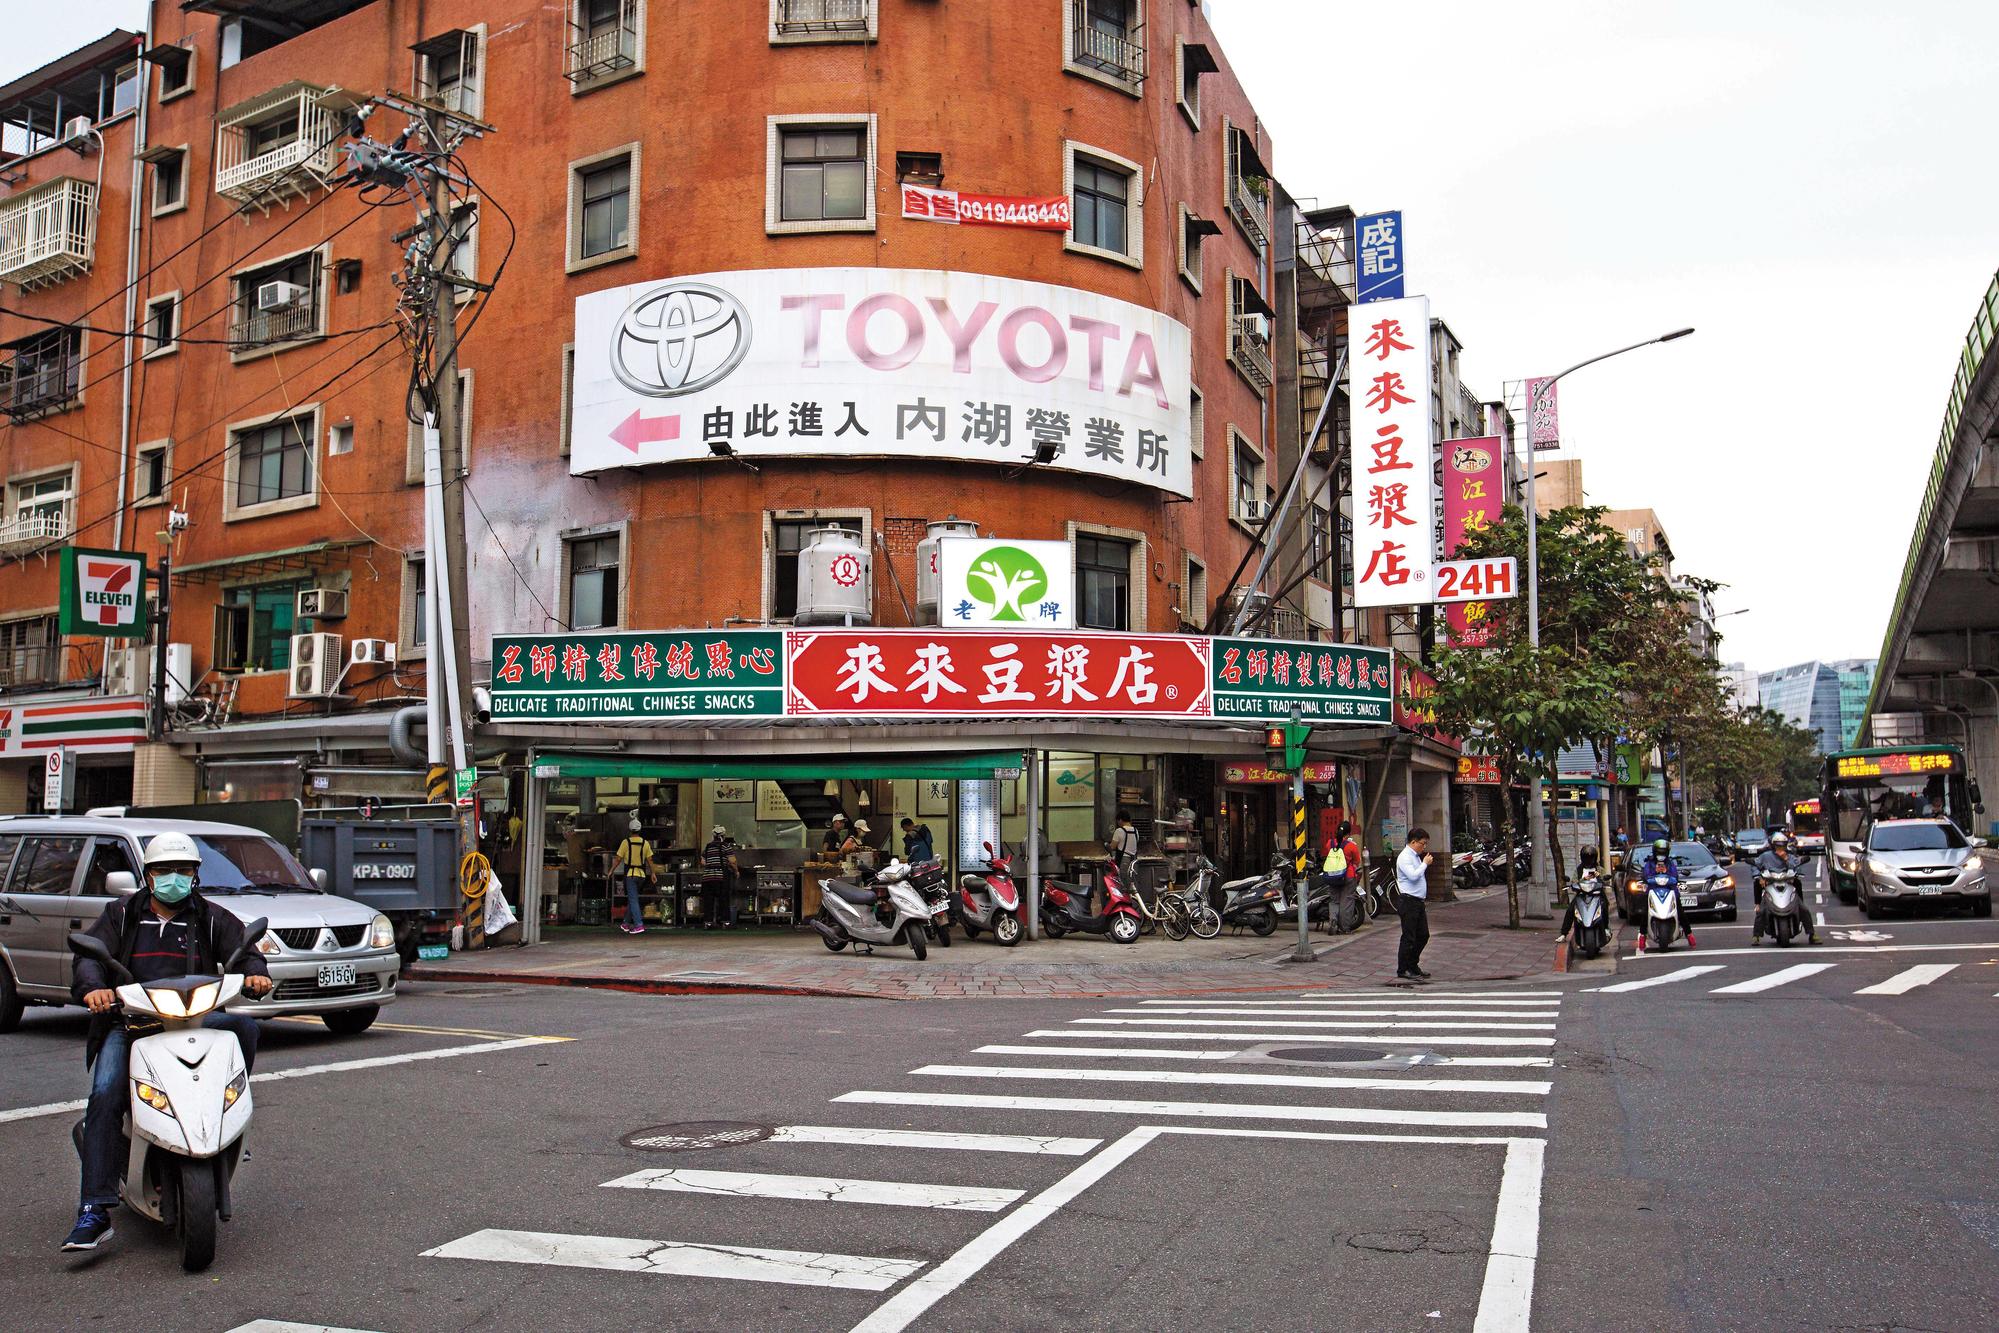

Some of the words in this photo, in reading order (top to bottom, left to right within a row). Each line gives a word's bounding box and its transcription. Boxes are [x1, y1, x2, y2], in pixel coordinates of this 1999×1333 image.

[960, 200, 1069, 223] 0919448443
[1361, 217, 1398, 276] 成記
[780, 292, 1170, 411] TOYOTA
[702, 401, 870, 442] 由此進入
[1359, 318, 1418, 588] 來來豆漿店
[1437, 562, 1511, 598] 24H
[953, 599, 976, 620] 老
[1039, 601, 1062, 622] 牌
[496, 640, 776, 684] 名師精製傳統點心
[835, 642, 1159, 705] 來來豆漿店
[1218, 648, 1389, 691] 名師精製傳統點心
[494, 697, 548, 713] DELICATE
[556, 697, 635, 712] TRADITIONAL
[643, 695, 696, 711] CHINESE
[704, 694, 755, 710] SNACKS
[1217, 697, 1263, 714] DELICATE
[1324, 701, 1354, 716] CHINESE
[1357, 703, 1381, 717] SNACKS
[353, 864, 416, 879] KPA-0907
